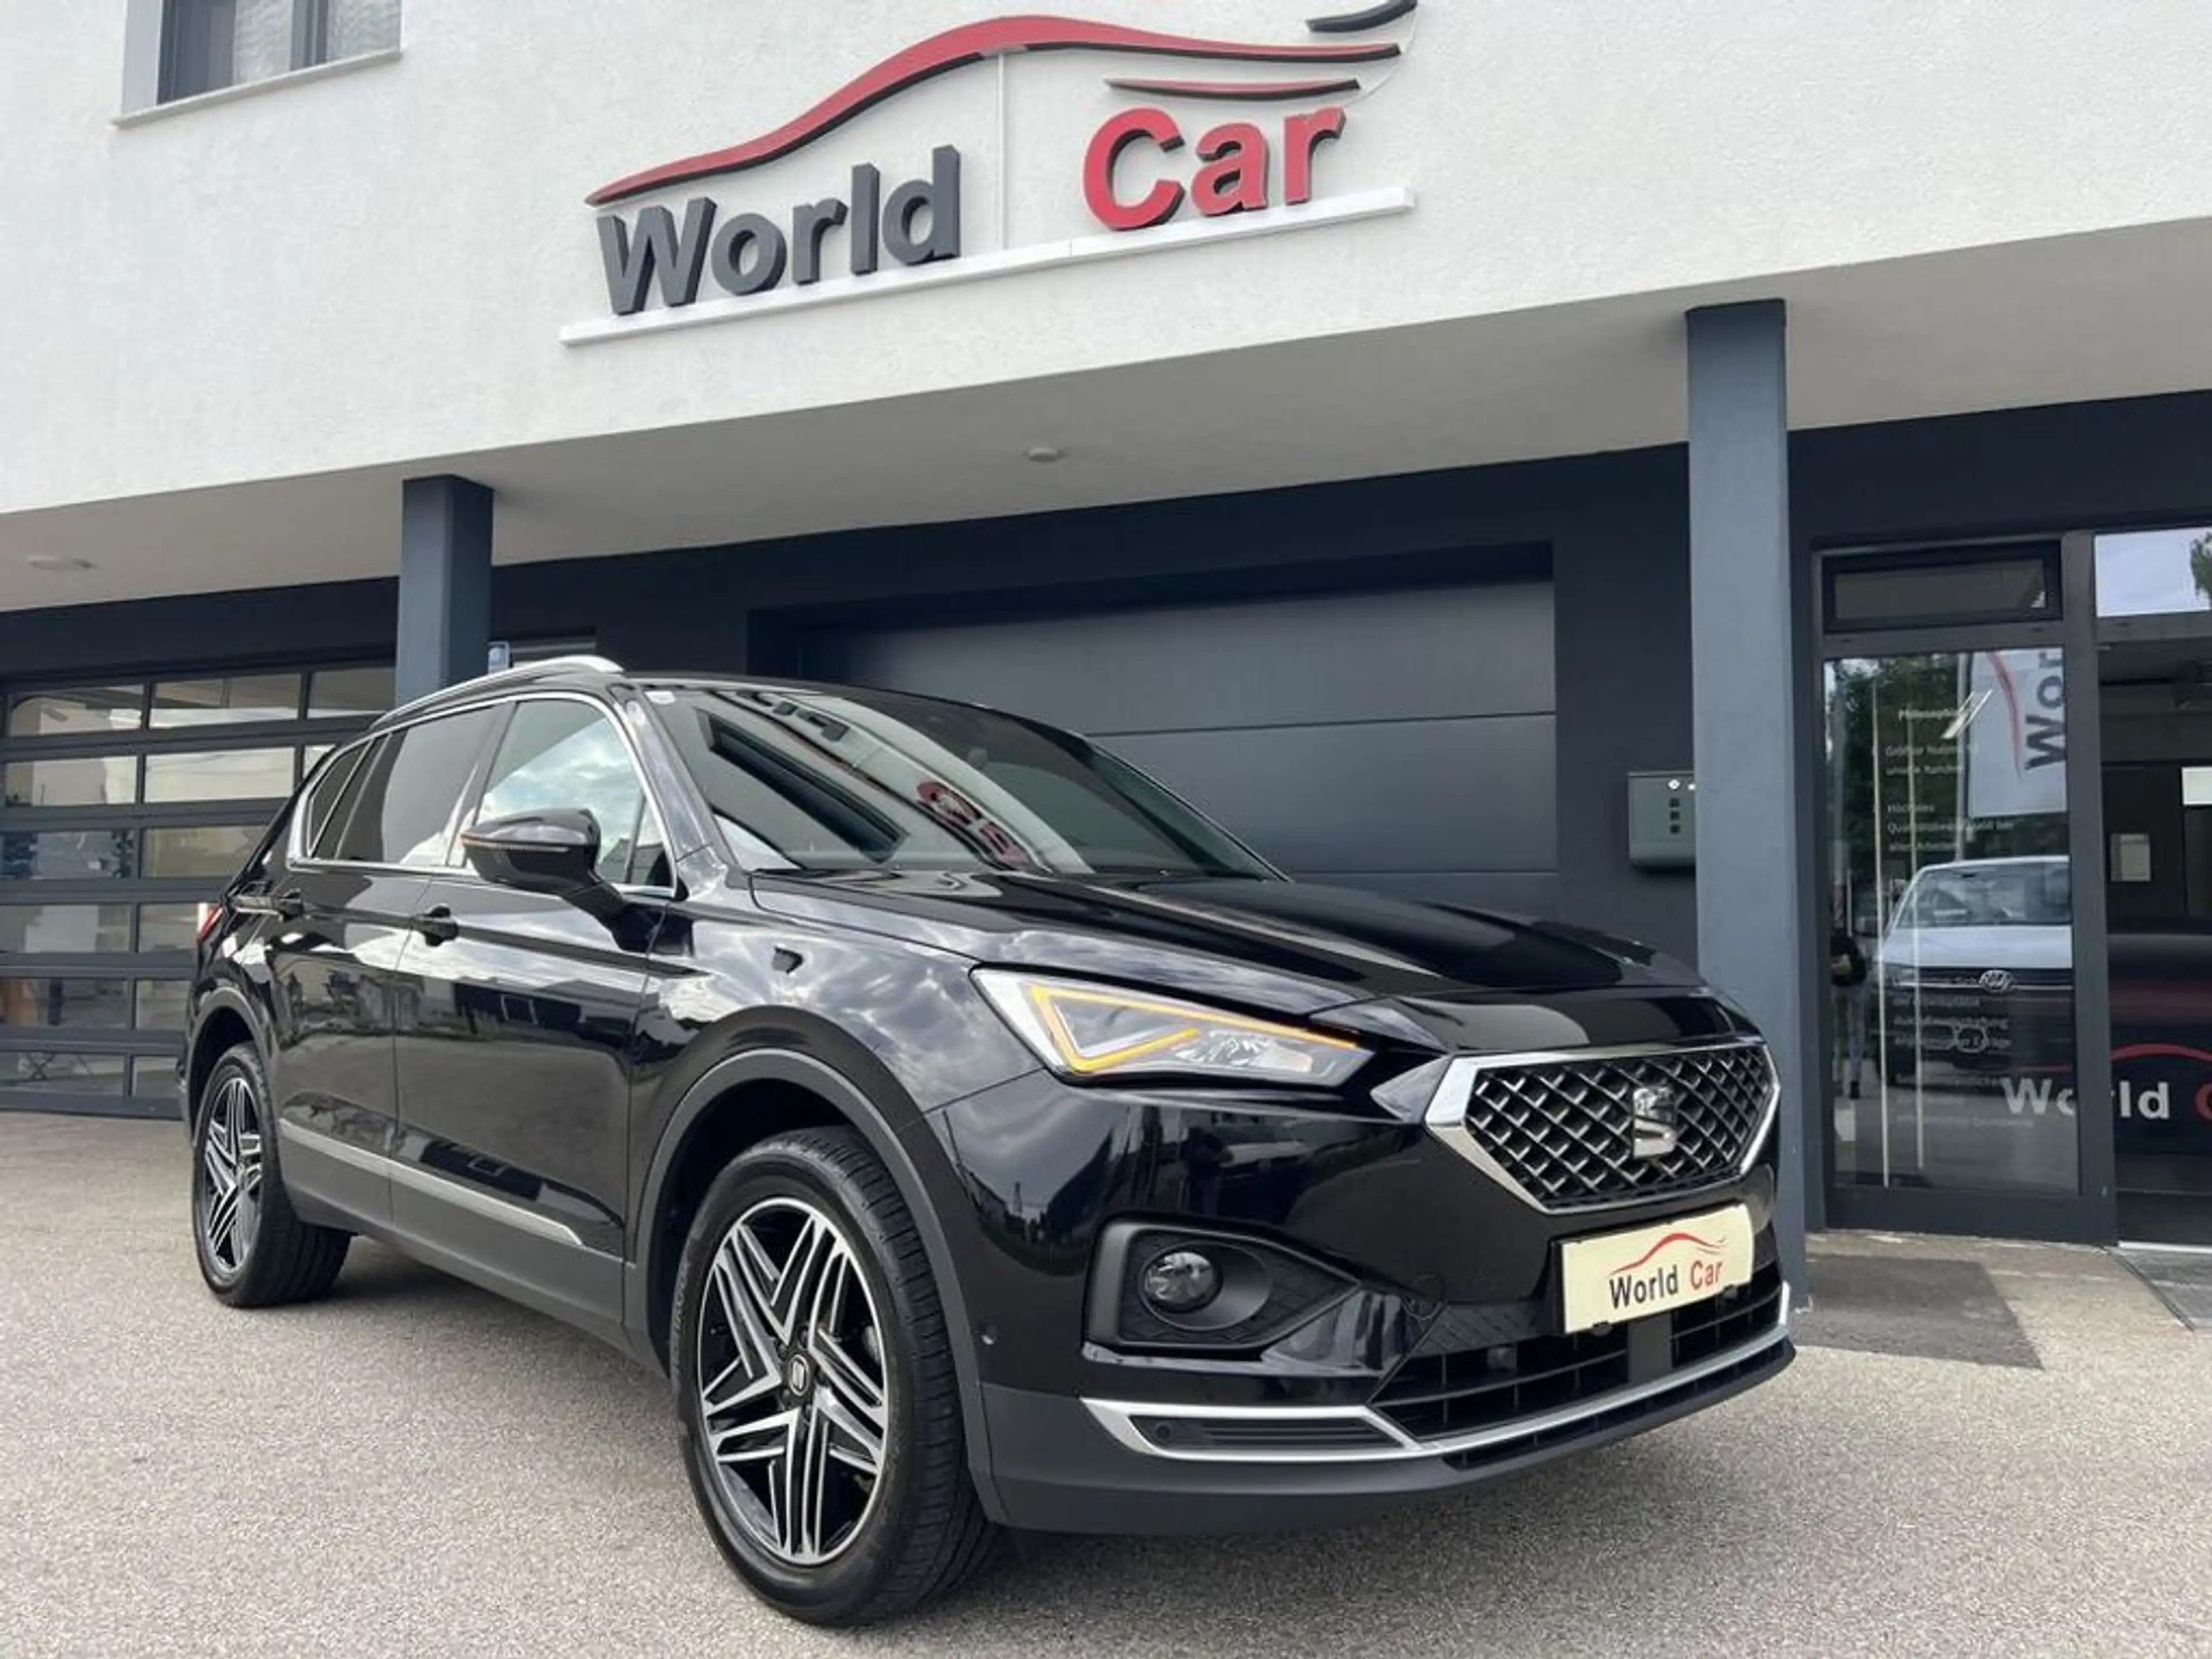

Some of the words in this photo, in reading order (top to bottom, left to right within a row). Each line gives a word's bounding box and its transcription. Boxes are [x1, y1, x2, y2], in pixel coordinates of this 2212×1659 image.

[596, 144, 961, 316] World
[1083, 105, 1345, 230] Car
[1609, 1264, 1679, 1309] World
[1690, 1259, 1722, 1290] Car
